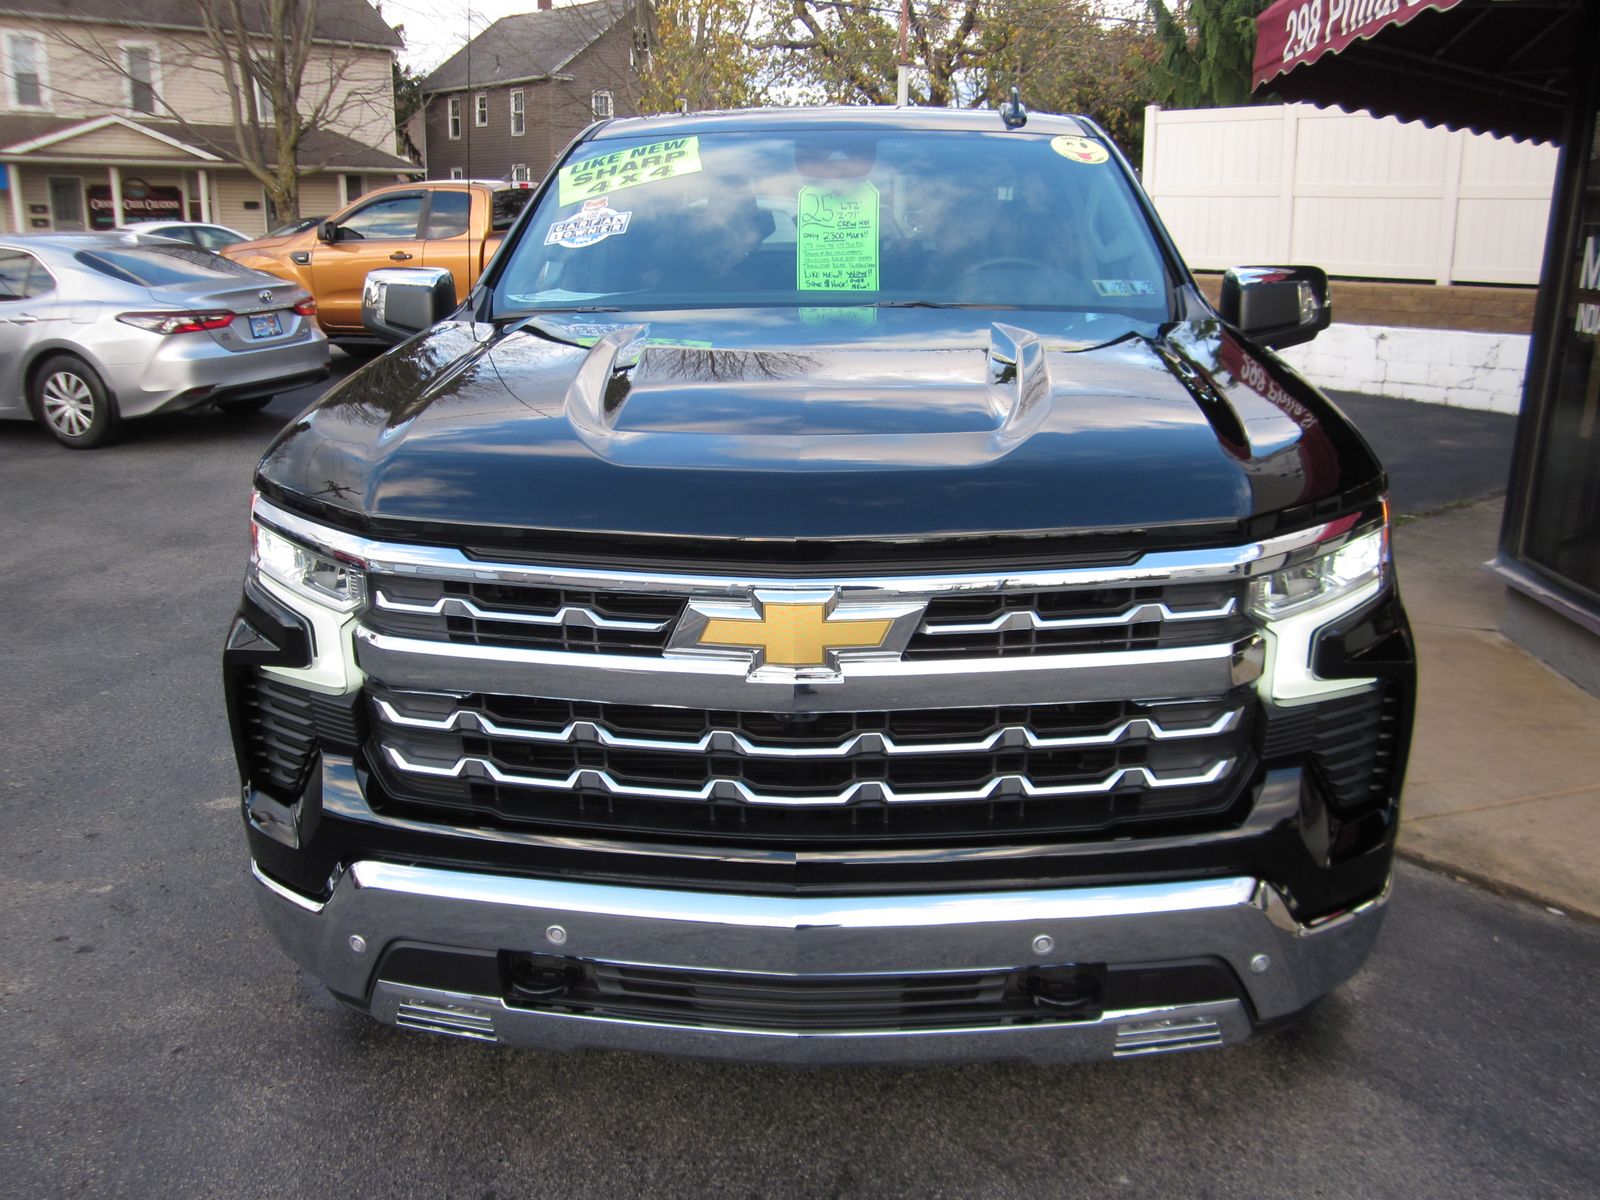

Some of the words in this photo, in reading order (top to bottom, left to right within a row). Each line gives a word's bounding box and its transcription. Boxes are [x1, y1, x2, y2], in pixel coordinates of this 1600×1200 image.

[1283, 0, 1321, 63] 298
[570, 152, 624, 175] LIKE
[630, 139, 687, 158] NEW
[573, 151, 685, 186] SHARP
[802, 193, 834, 222] 25
[554, 213, 625, 232] CARFAX
[563, 224, 622, 238] OWNER
[823, 231, 845, 240] 2300
